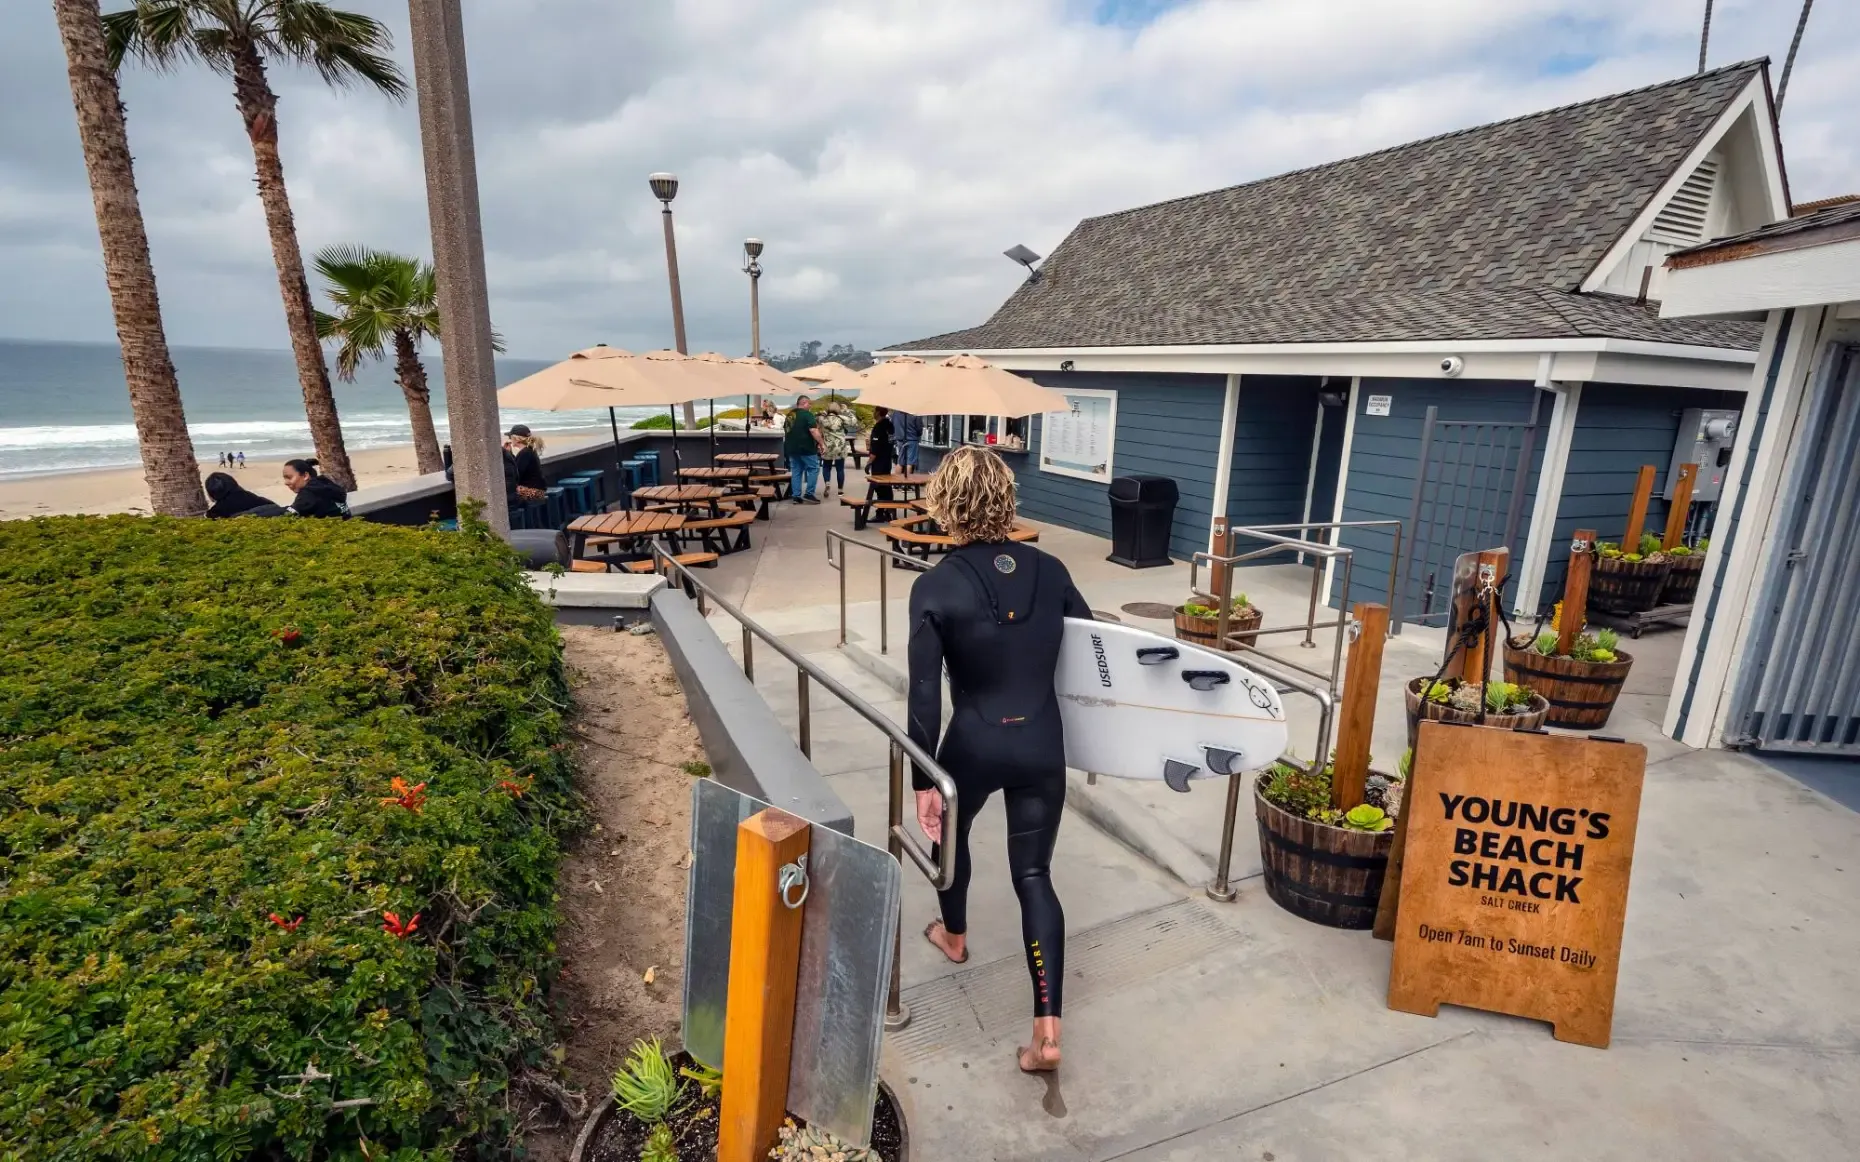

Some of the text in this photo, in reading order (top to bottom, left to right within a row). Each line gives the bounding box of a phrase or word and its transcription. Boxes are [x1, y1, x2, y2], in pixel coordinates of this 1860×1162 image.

[1091, 633, 1112, 687] USEDSURF
[1439, 792, 1611, 839] YOUNG'S
[1453, 828, 1584, 870] BEACH
[1448, 860, 1583, 904] SHACK
[1480, 896, 1540, 914] SALT CREEK
[1418, 923, 1597, 969] Open 7am to Sunset Daily
